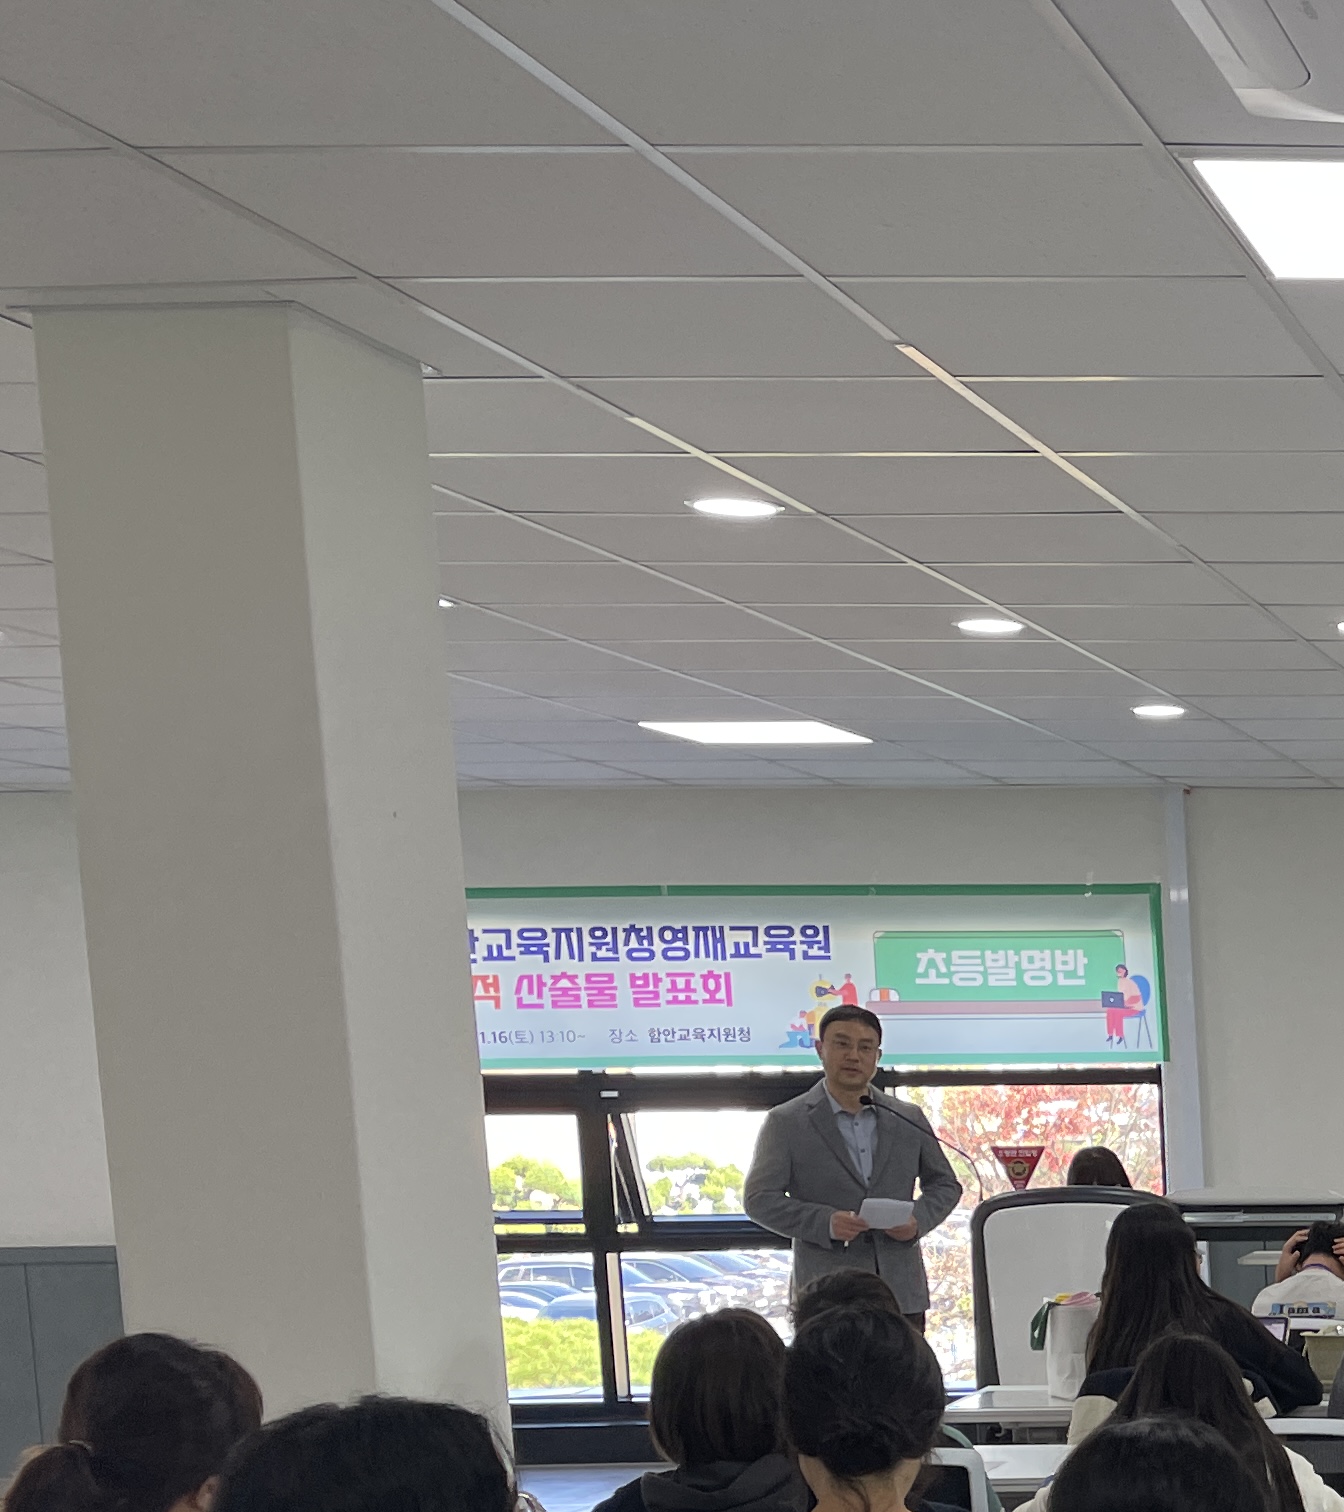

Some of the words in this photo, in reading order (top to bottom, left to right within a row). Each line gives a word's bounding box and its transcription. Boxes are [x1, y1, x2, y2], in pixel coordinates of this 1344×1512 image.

[914, 948, 1090, 988] 초등발명반
[514, 971, 618, 1010] 산출물
[629, 969, 734, 1008] 발표회
[608, 1028, 639, 1044] 장소
[648, 1026, 752, 1044] 함안교육지원청
